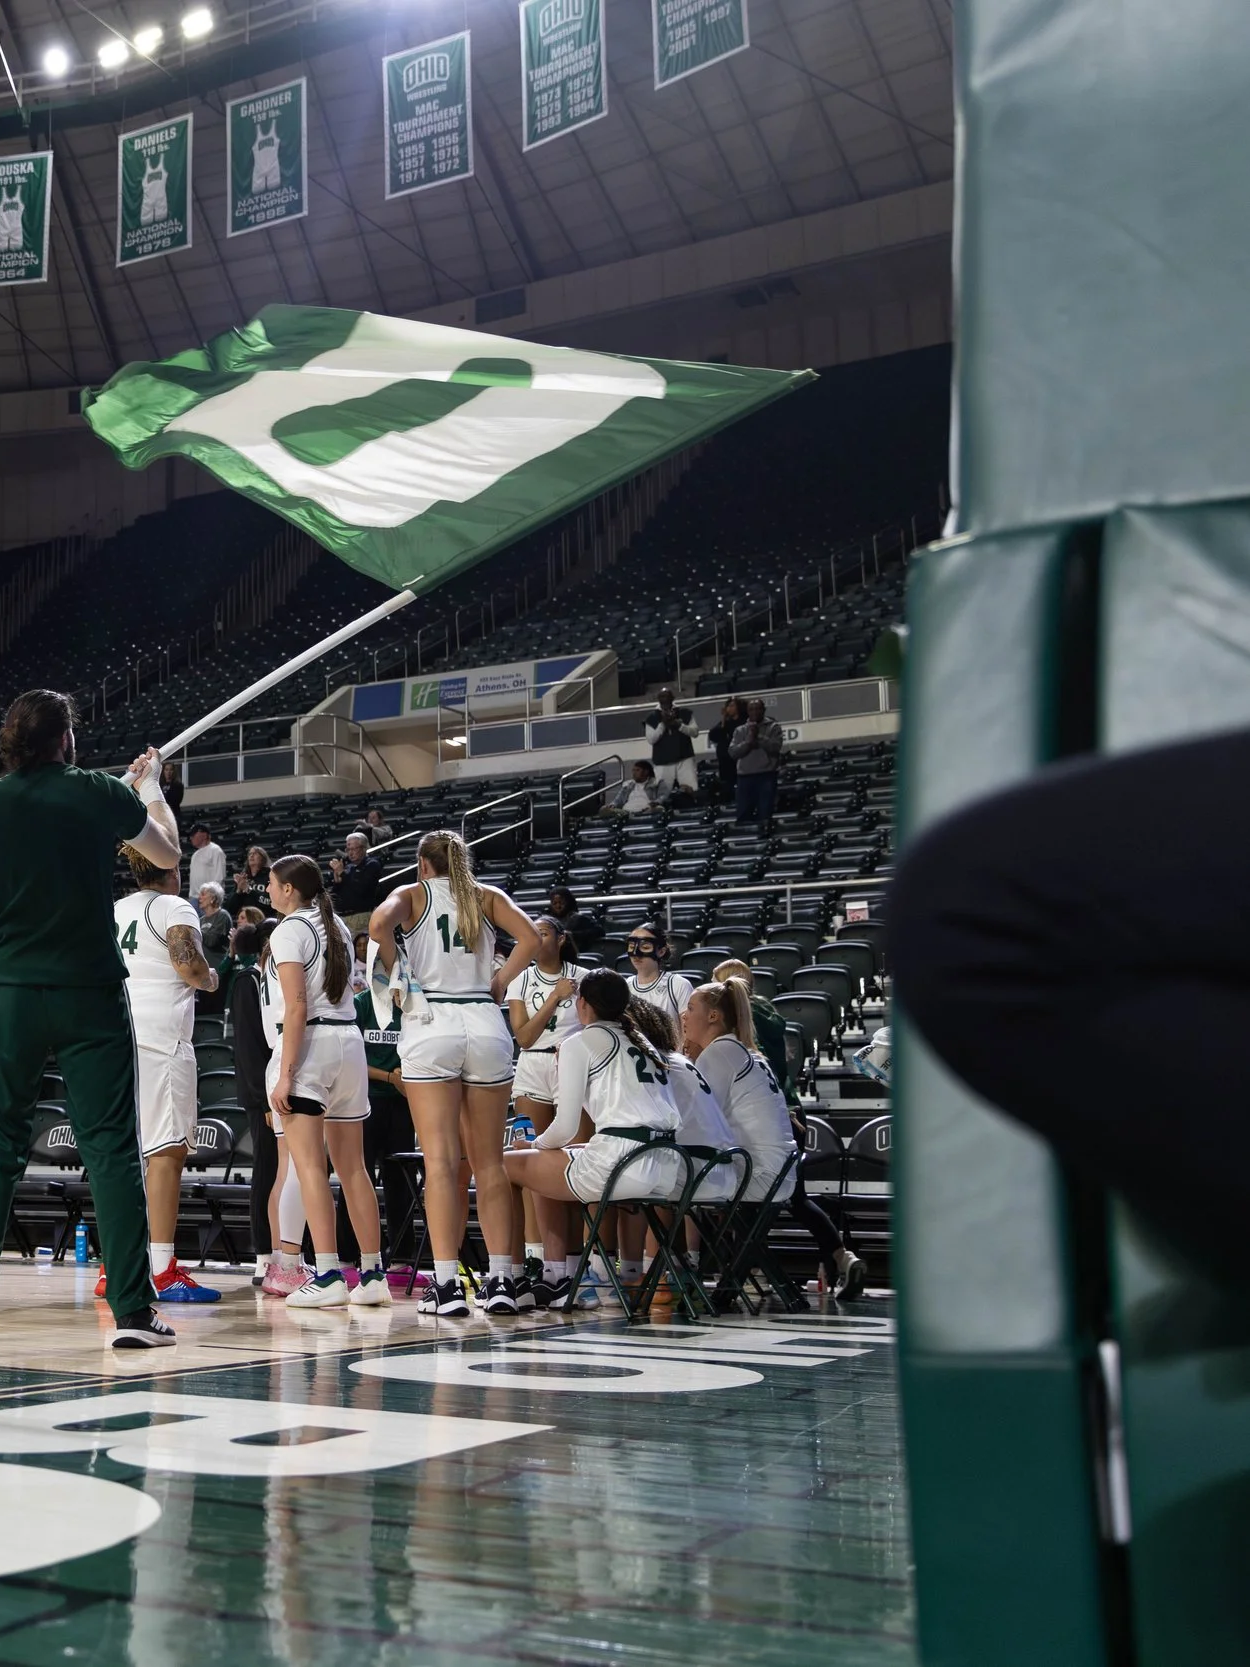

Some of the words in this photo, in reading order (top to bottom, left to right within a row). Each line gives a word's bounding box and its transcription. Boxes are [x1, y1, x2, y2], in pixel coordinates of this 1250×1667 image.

[539, 0, 584, 37] OHIO
[668, 19, 697, 42] 1995
[703, 4, 730, 25] 1997
[551, 40, 575, 60] MAC
[668, 34, 697, 56] 2001
[403, 53, 449, 93] OHIO
[529, 41, 598, 82] TOURNAMENT
[533, 56, 593, 92] CHAMPIONS
[407, 83, 447, 102] WRESTLING
[535, 85, 562, 107] 1973
[567, 72, 594, 93] 1974
[240, 91, 292, 117] GARDNER
[415, 99, 440, 116] MAC
[535, 113, 562, 133] 1993
[569, 98, 595, 119] 1994
[393, 104, 463, 133] TOURNAMENT
[397, 117, 459, 144] CHAMPIONS
[134, 126, 176, 150] DANIELS
[398, 142, 425, 159] 1955
[431, 133, 459, 149] 1956
[398, 155, 425, 171] 1957
[432, 145, 459, 162] 1970
[399, 167, 425, 184] 1971
[432, 159, 460, 175] 1972
[235, 193, 299, 217] CHAMPION
[237, 185, 296, 208] NATIONAL
[247, 206, 286, 223] 1996
[124, 225, 183, 248] CHAMPION
[127, 218, 180, 239] NATIONAL
[513, 679, 527, 687] OH
[114, 920, 138, 954] 4
[369, 1032, 381, 1042] GO
[196, 1125, 217, 1149] HIO
